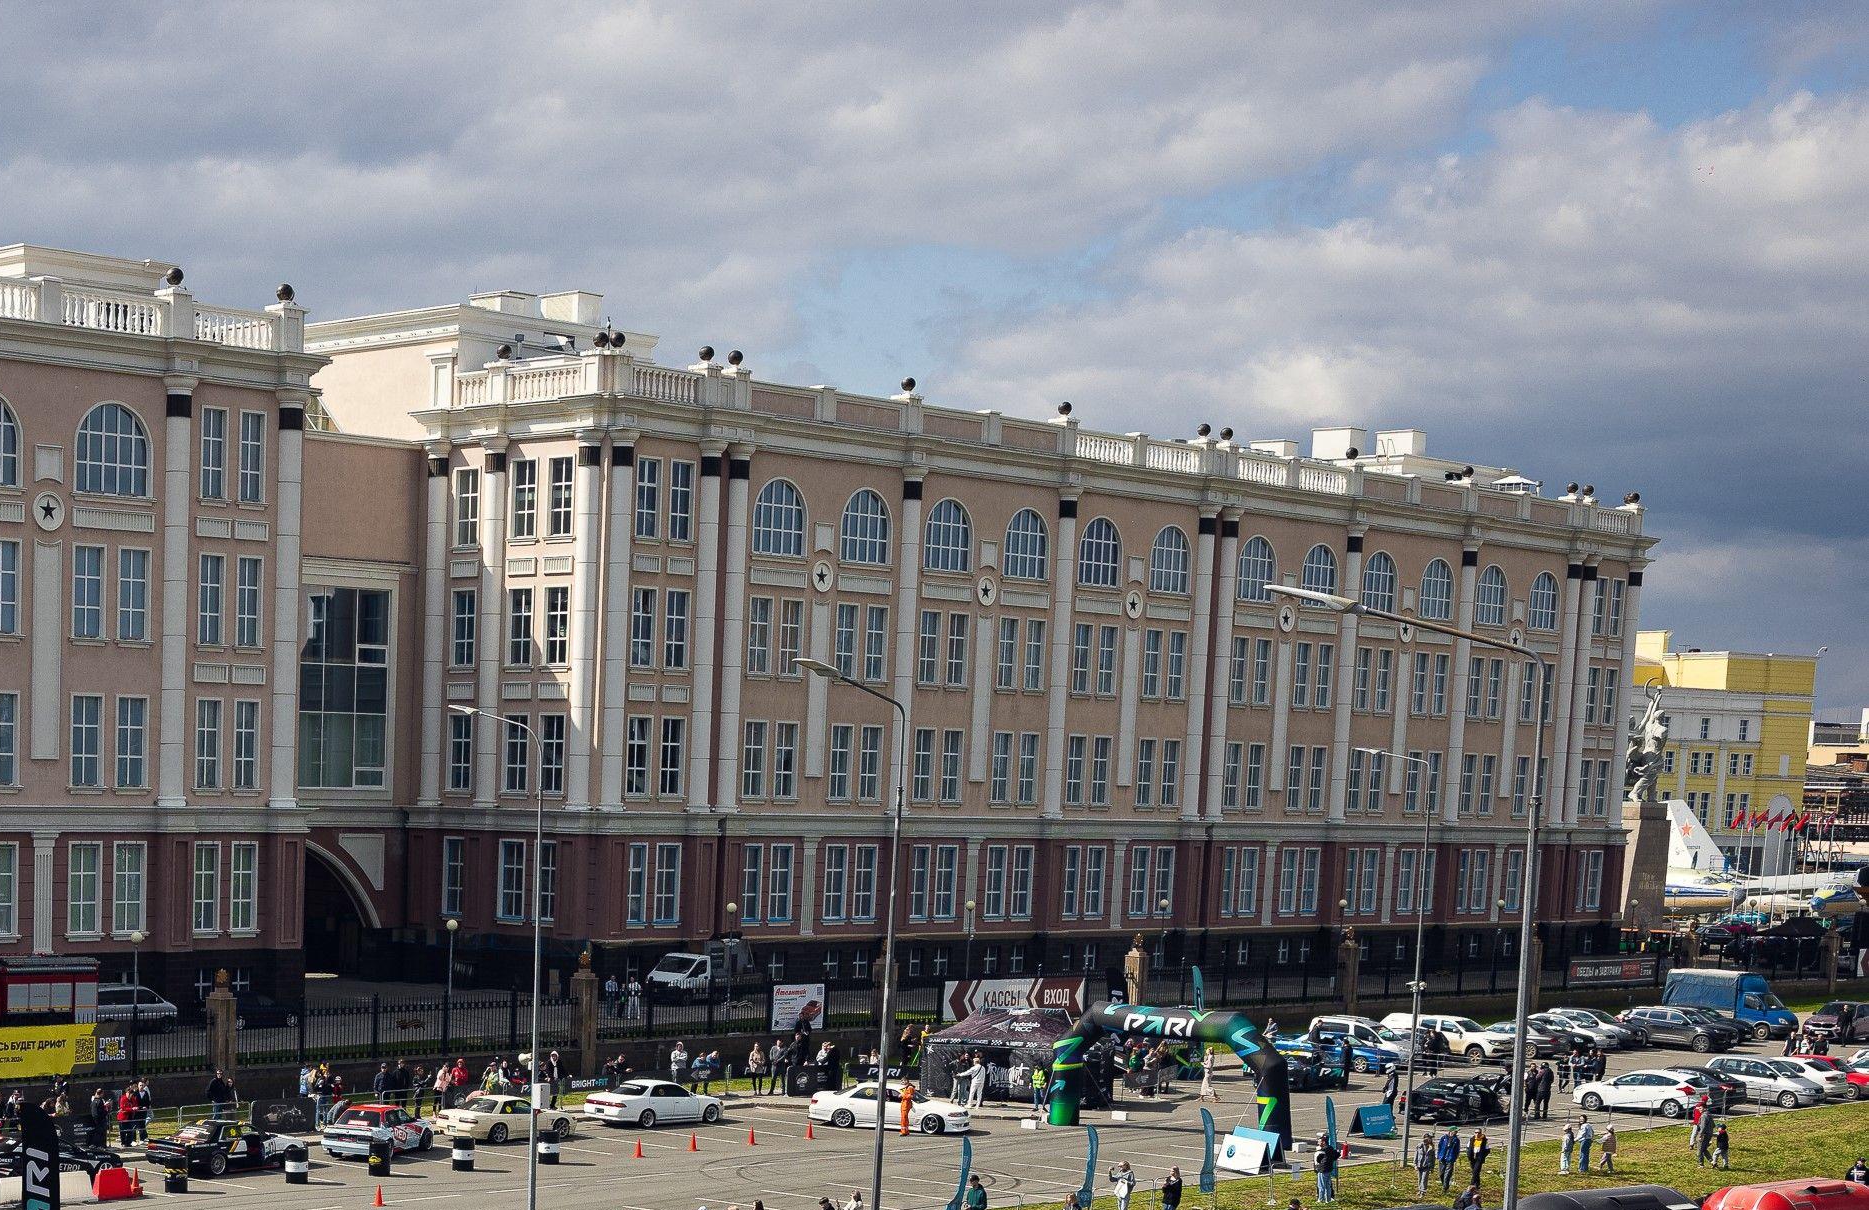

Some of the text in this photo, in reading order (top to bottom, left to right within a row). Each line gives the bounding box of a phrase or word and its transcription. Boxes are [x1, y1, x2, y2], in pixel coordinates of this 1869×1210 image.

[983, 990, 1021, 1008] КАССЫ
[1043, 988, 1070, 1006] ВХОД
[1123, 1013, 1196, 1037] PARI
[10, 1040, 36, 1052] БУДЕТ
[37, 1039, 67, 1050] ДРИФТ
[867, 1067, 901, 1077] PRI
